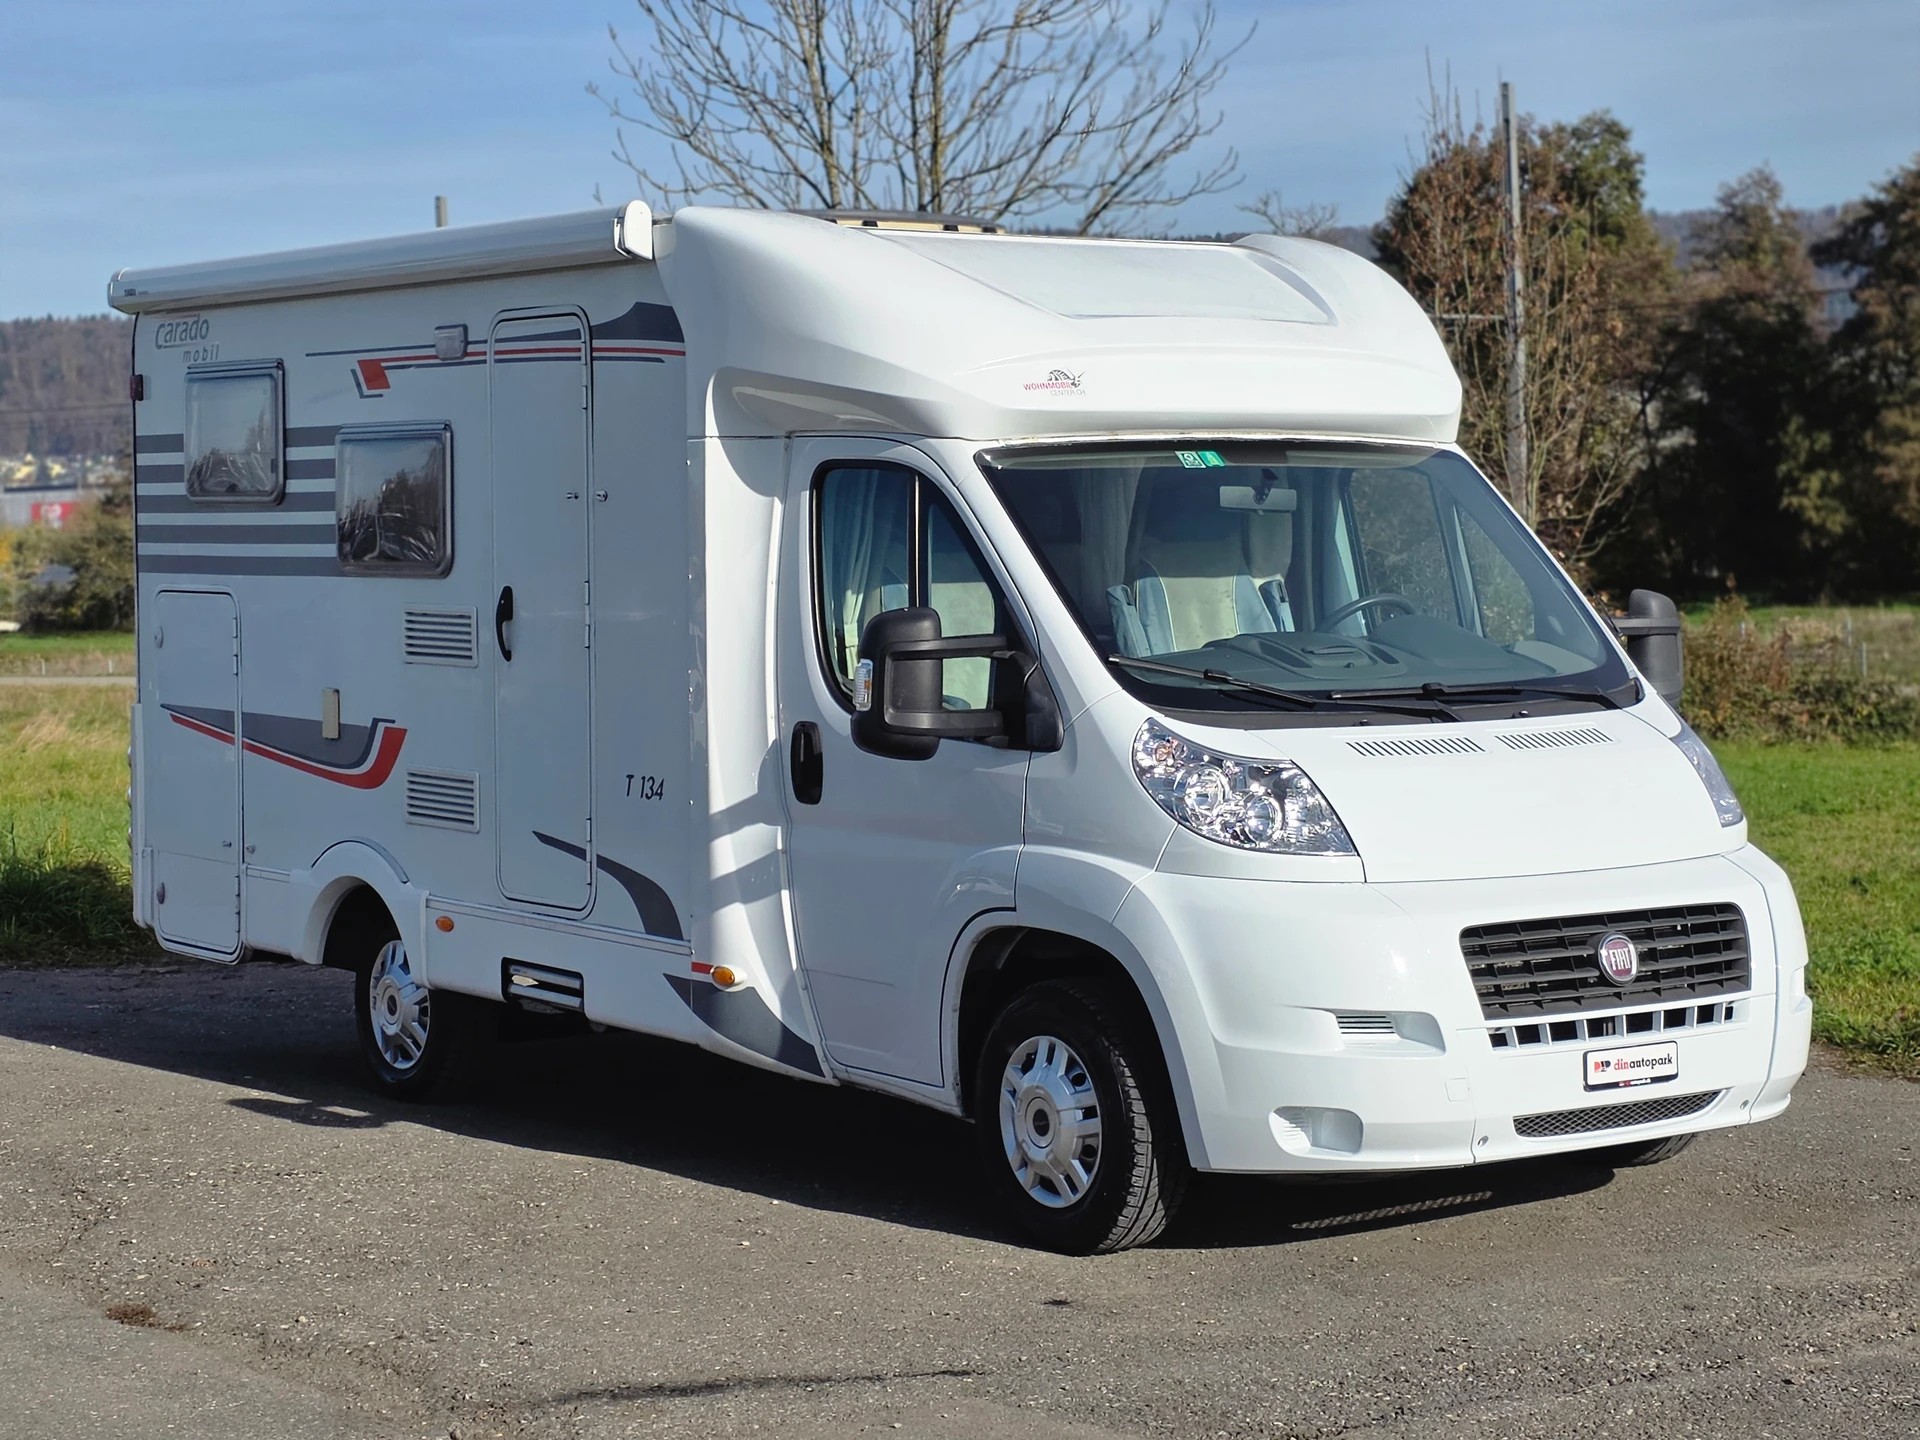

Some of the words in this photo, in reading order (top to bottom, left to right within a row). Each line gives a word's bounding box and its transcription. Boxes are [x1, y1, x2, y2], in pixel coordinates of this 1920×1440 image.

[183, 344, 219, 362] mobil
[1023, 381, 1073, 390] WOHNMOBIL
[626, 774, 635, 797] T
[641, 775, 665, 800] 134
[1608, 947, 1631, 970] FIAT
[1613, 1053, 1673, 1071] dinautopark
